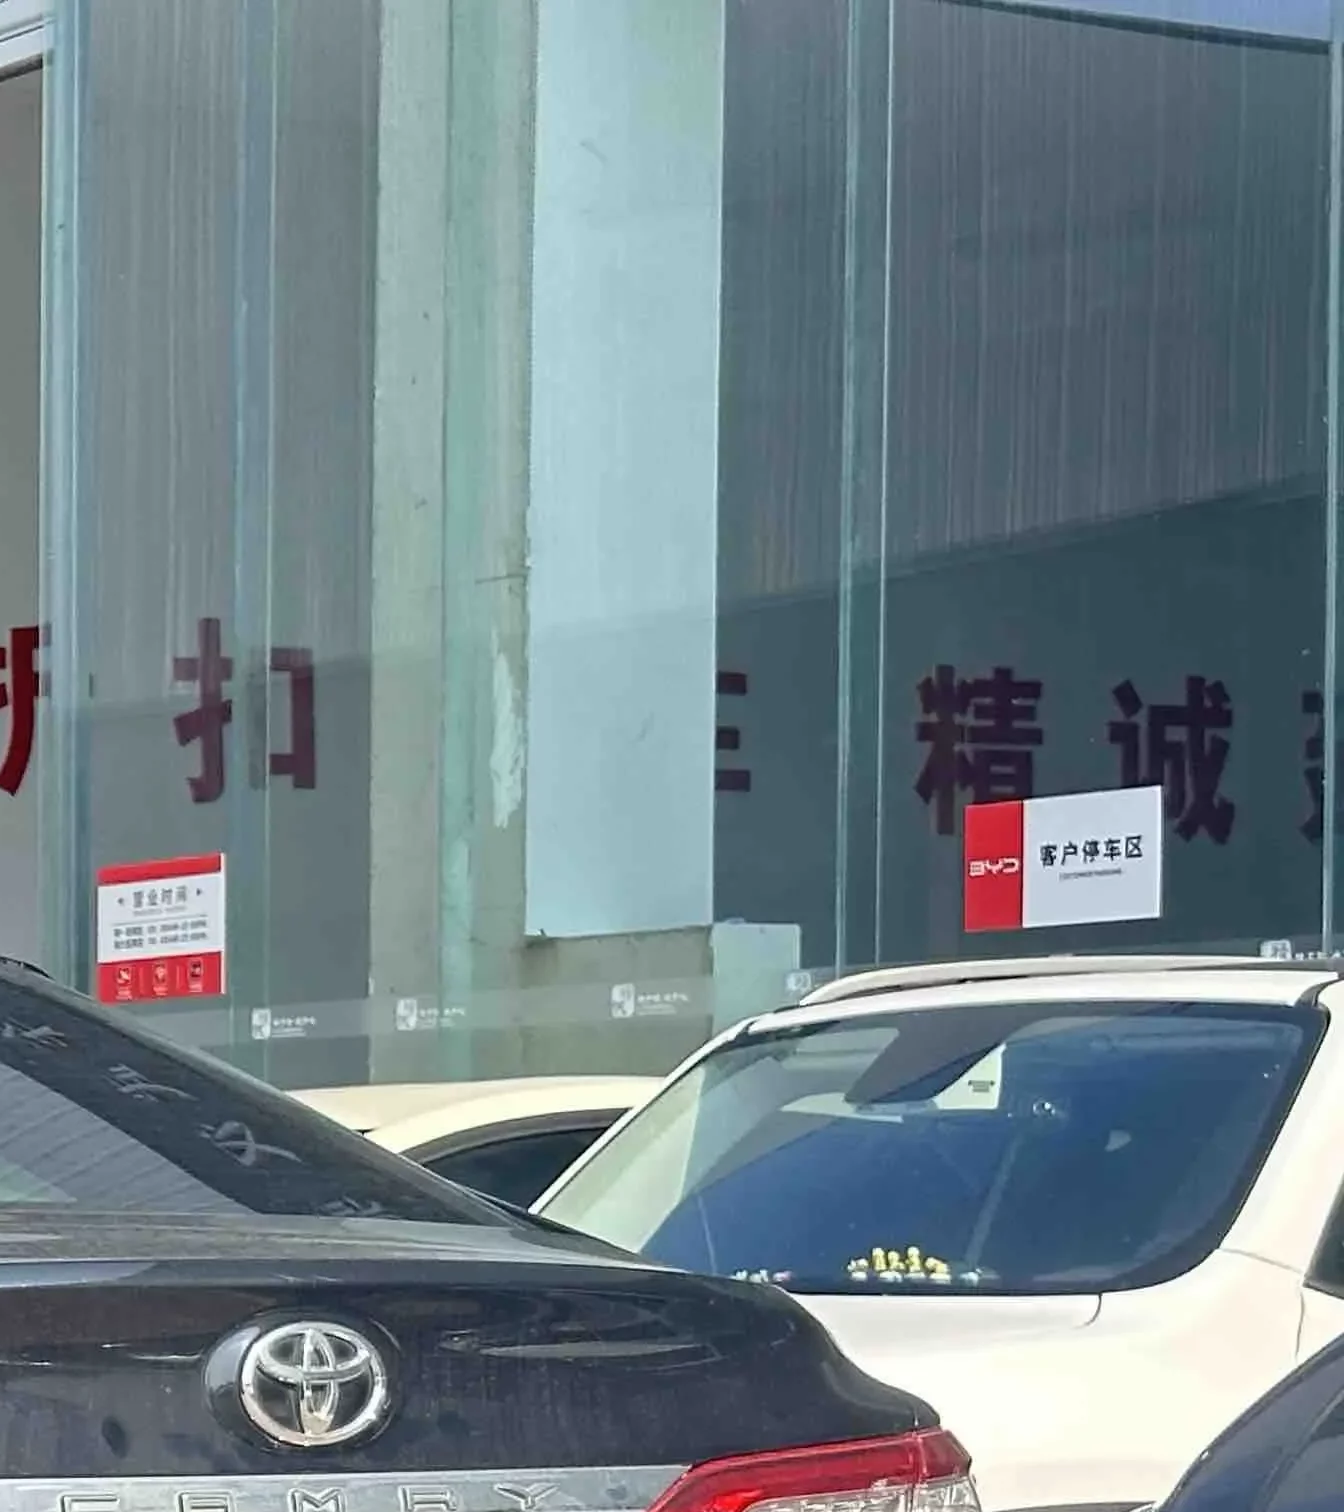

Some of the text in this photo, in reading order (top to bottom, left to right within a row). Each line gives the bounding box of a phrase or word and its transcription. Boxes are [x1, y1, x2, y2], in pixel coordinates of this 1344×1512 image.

[1039, 834, 1143, 867] 客户停车区
[969, 857, 1020, 877] BYD
